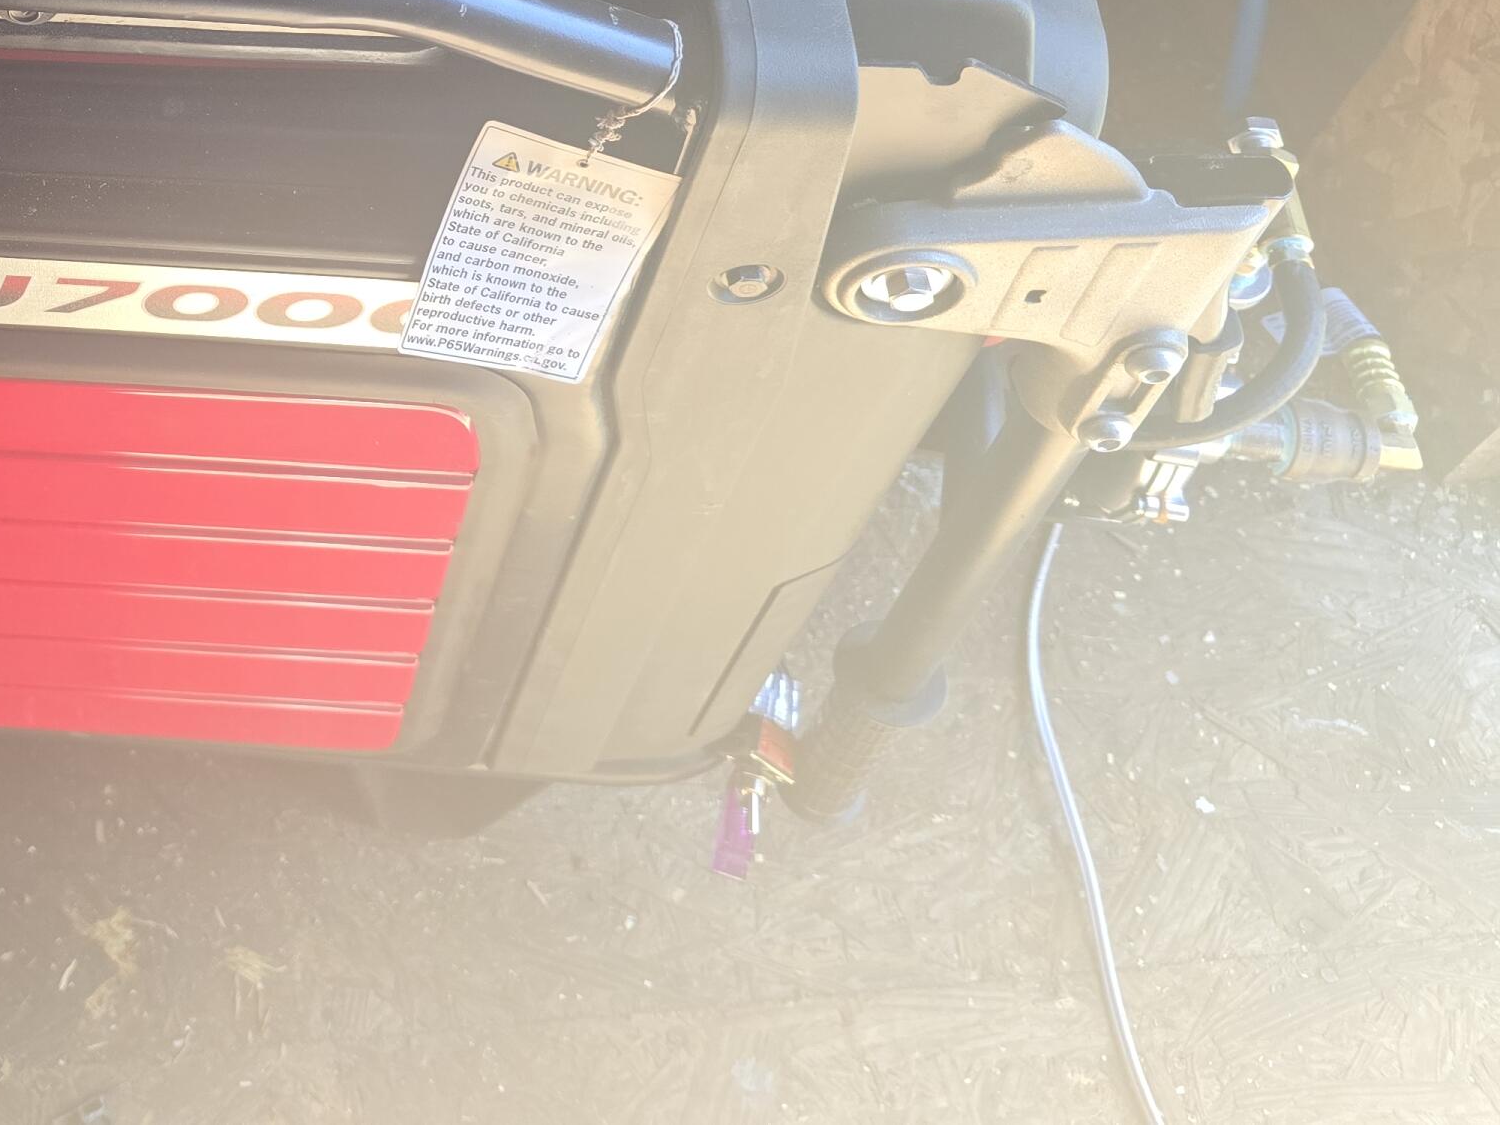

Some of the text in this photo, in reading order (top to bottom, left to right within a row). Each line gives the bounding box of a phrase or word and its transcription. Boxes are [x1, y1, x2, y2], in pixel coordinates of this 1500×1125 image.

[468, 165, 634, 220] This product can expose
[523, 159, 646, 207] WARNING:
[451, 205, 604, 252] which are known to the
[456, 193, 639, 248] soots, tars, and mineral oils,
[462, 180, 643, 237] you to chemicals including
[441, 234, 549, 267] to cause cancer,
[446, 219, 567, 257] State of California
[430, 260, 569, 299] which is known to the
[435, 247, 582, 289] and carbon monoxide,
[414, 303, 538, 336] reproductive harm.
[420, 290, 558, 326] birth defects or other
[426, 276, 601, 321] State of California to cause
[409, 317, 582, 359] For more information go to
